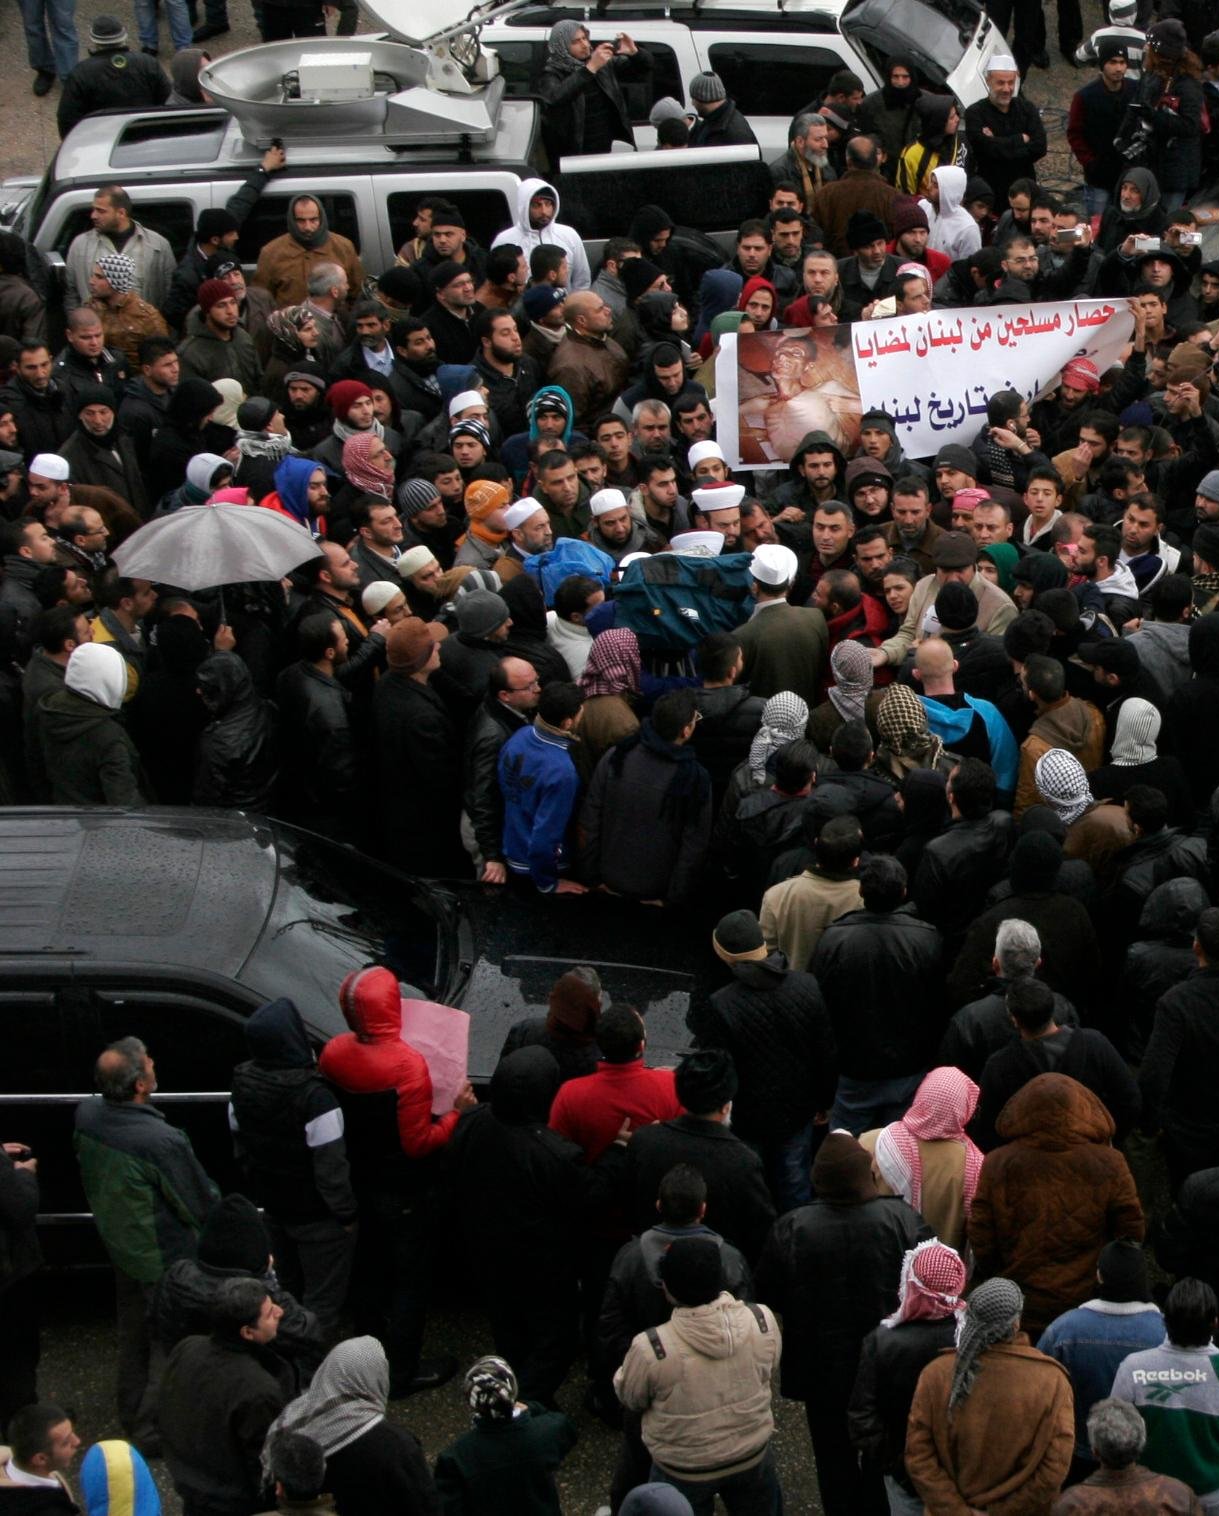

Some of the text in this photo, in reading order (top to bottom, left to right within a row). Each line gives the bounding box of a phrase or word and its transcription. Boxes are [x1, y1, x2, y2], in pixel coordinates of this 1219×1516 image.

[856, 302, 1116, 368] حصار مسلحين من لبنان لمضايا
[869, 395, 921, 432] لبنا
[927, 385, 989, 432] تاريخ
[1131, 1368, 1208, 1385] Reebok
